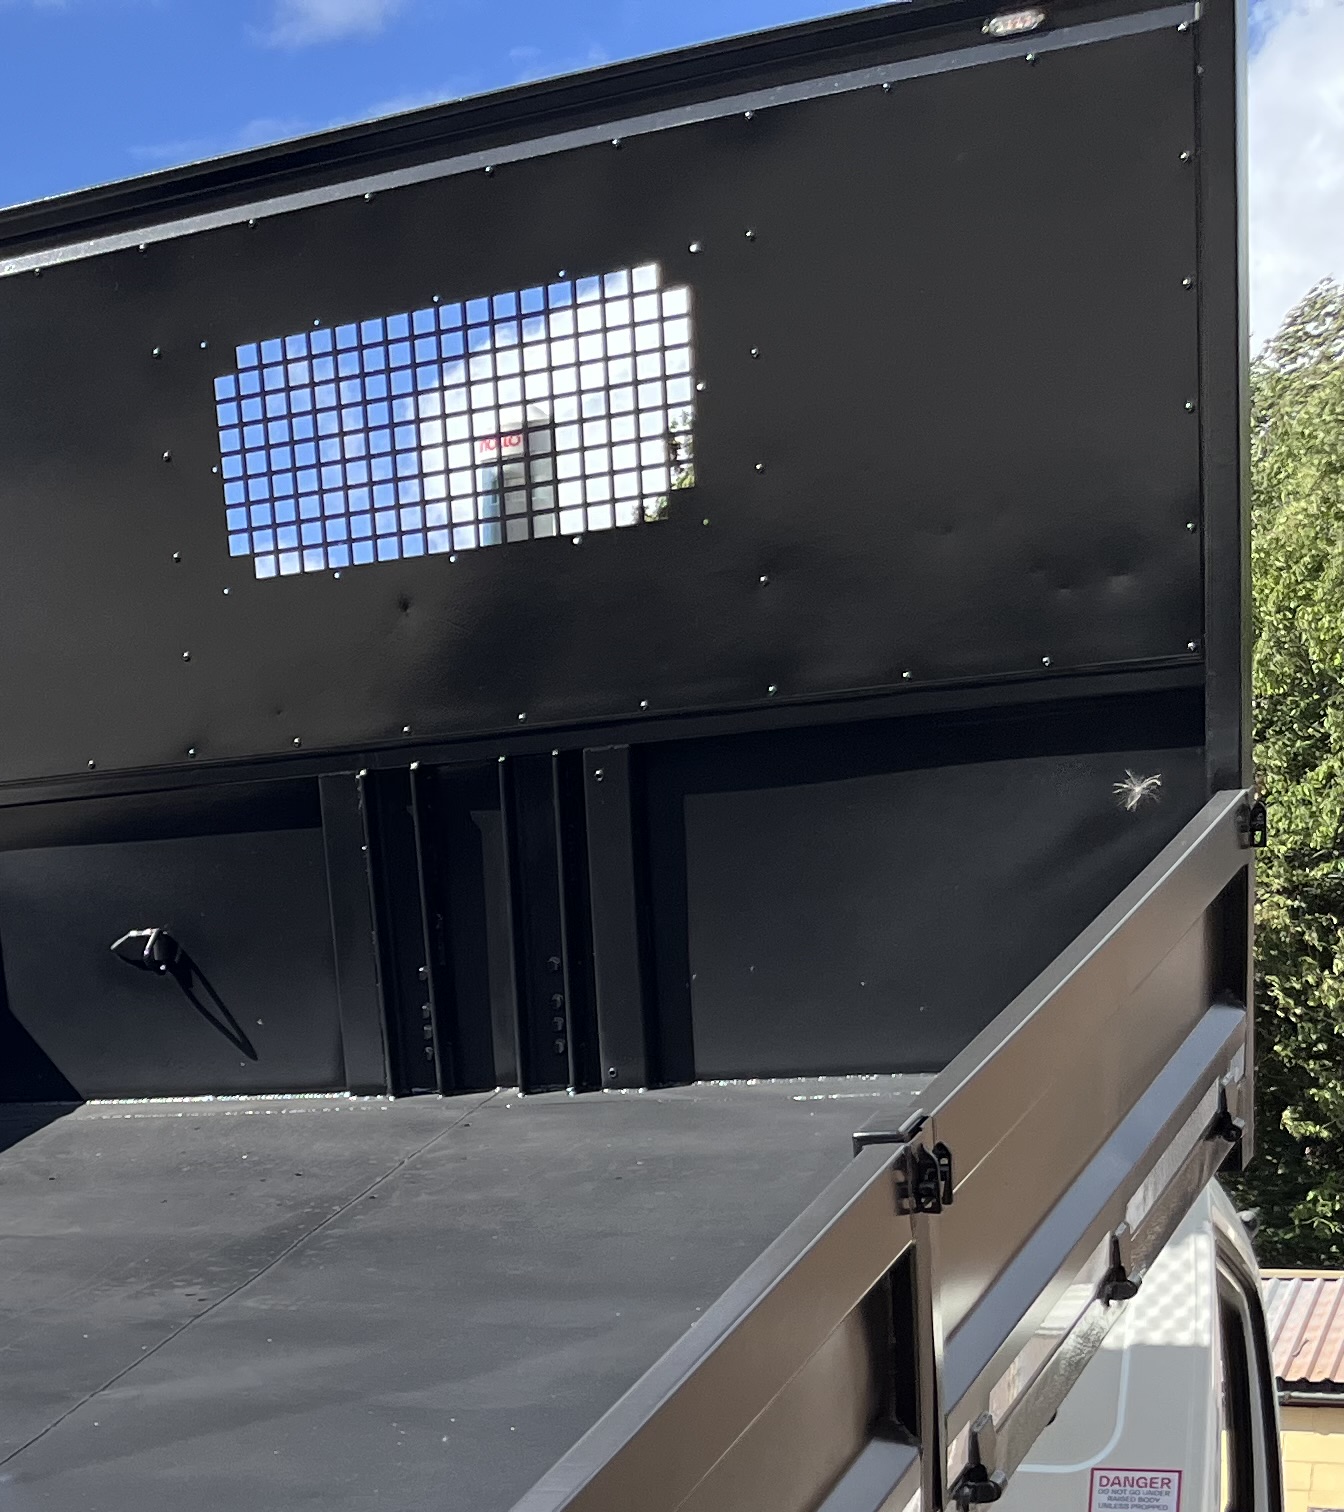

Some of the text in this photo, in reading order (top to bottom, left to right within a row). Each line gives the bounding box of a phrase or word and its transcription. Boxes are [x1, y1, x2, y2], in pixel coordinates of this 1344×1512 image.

[1098, 1475, 1172, 1490] DANGER
[1097, 1502, 1169, 1511] UNLESS PROPPED
